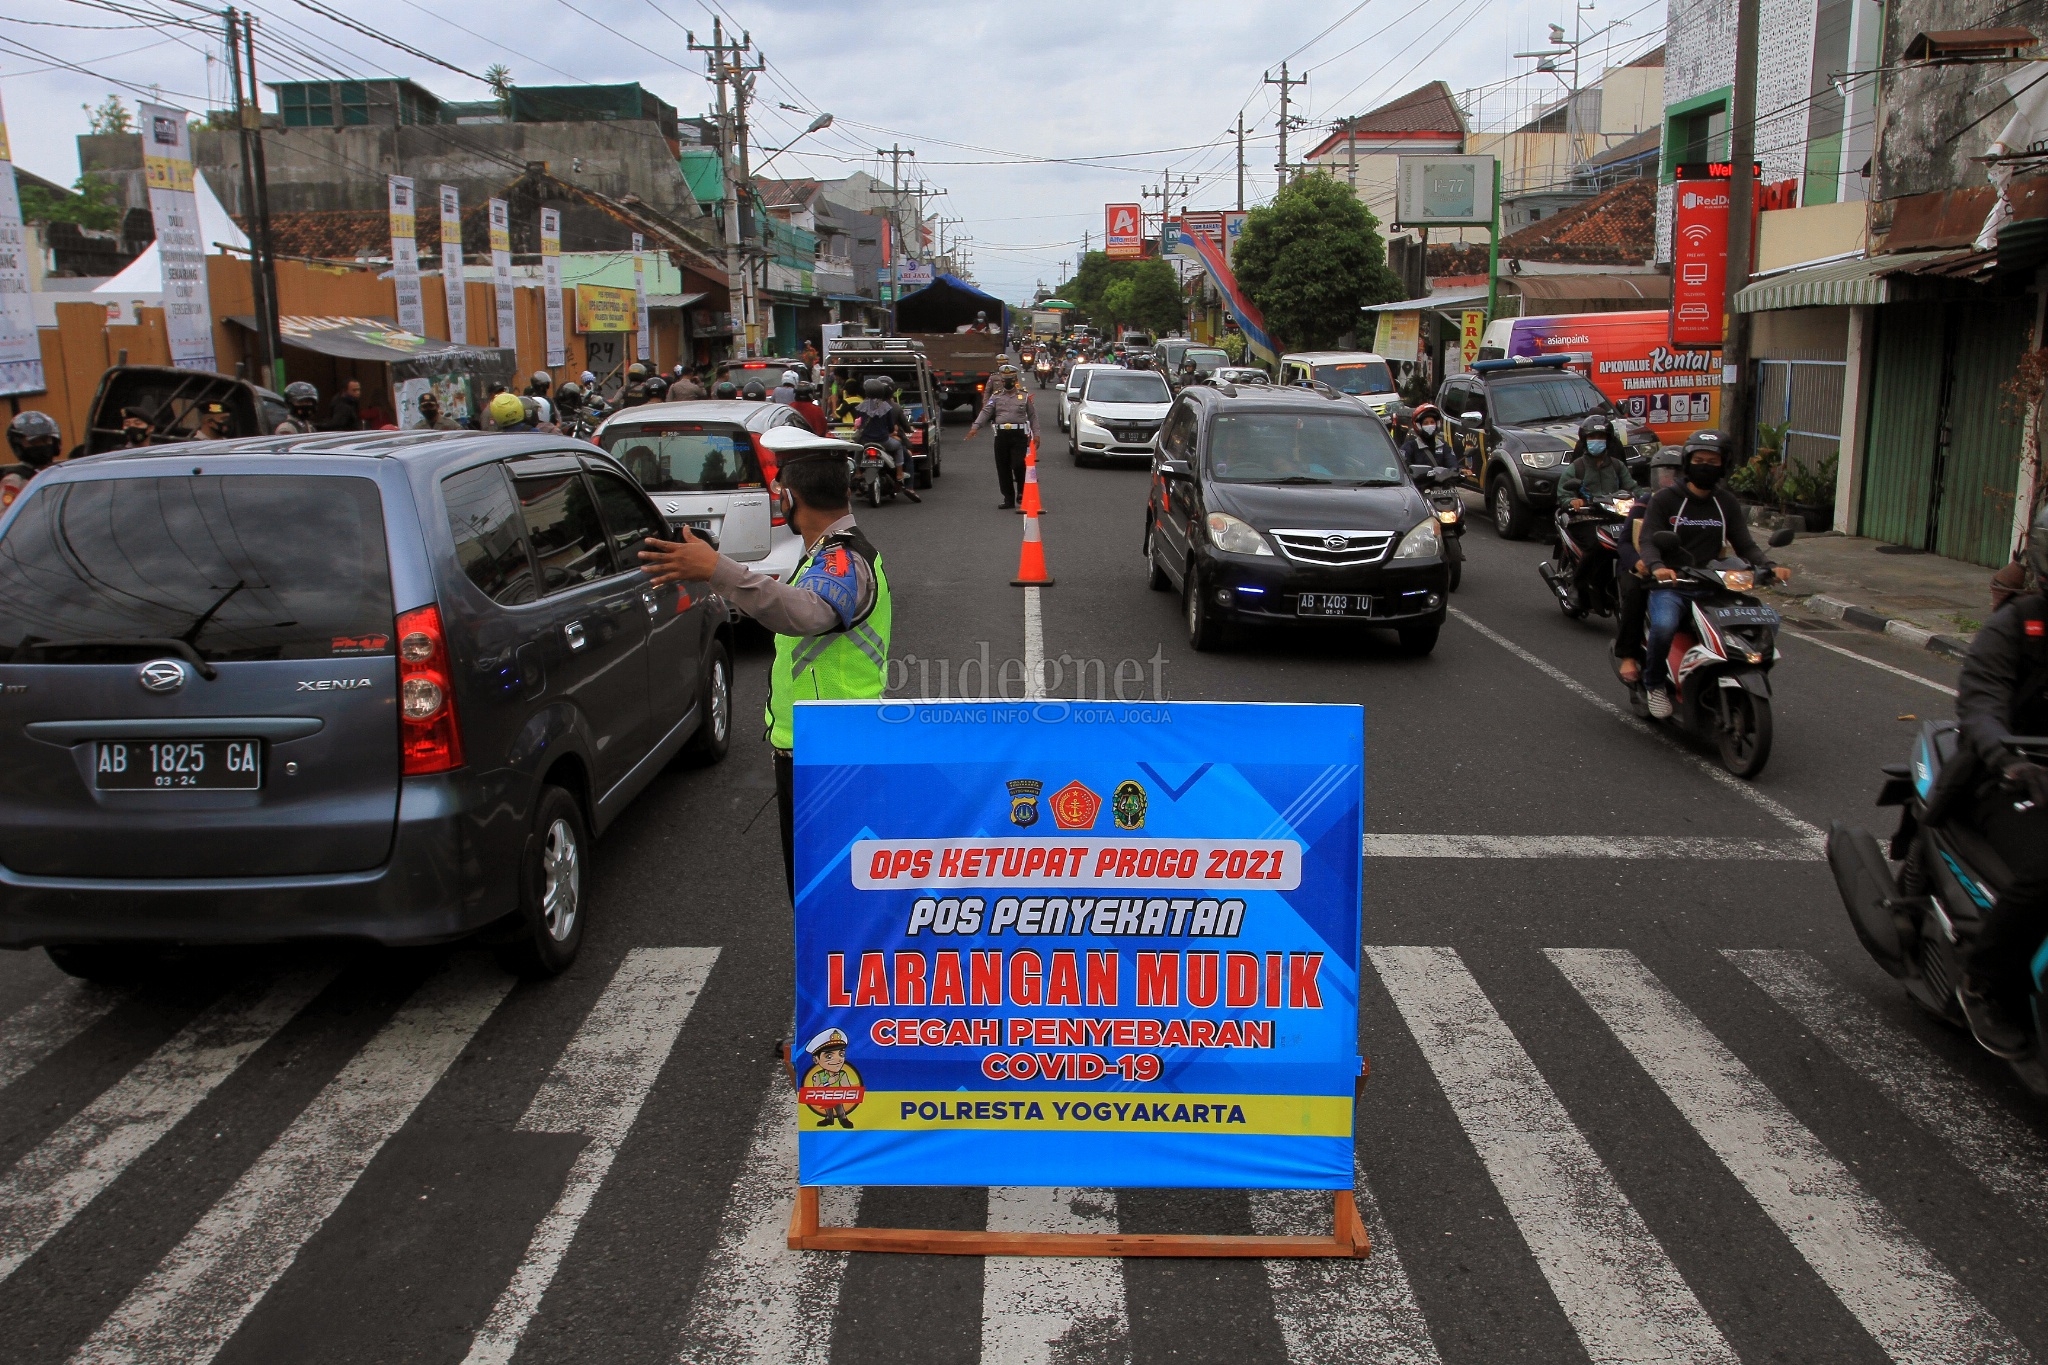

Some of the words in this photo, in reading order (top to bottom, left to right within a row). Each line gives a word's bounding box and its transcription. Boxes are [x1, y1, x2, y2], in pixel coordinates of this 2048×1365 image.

[1547, 333, 1590, 349] asianpaints
[1599, 359, 1650, 374] APKOVALUE
[1621, 376, 1669, 390] TAHANNYA
[1669, 374, 1695, 388] LAMA
[1301, 594, 1315, 608] AB
[1322, 595, 1348, 609] 1403
[1356, 596, 1369, 610] IU
[296, 677, 373, 692] XENIA
[98, 744, 128, 773] AB
[150, 743, 205, 773] 1825
[226, 743, 255, 772] GA
[869, 849, 933, 880] OPS
[938, 847, 1089, 879] KETUPAT
[1094, 848, 1199, 879] PROGO
[1204, 849, 1285, 880] 2021
[907, 897, 986, 937] POS
[990, 896, 1248, 938] PENYEKATAN
[826, 948, 1119, 1008] LARANGAN
[1136, 949, 1326, 1011] MUDIK
[870, 1017, 1003, 1048] CEGAH
[1008, 1018, 1276, 1049] PENYEBARAN
[980, 1052, 1165, 1082] COVID-19
[805, 1089, 860, 1100] PRESISI
[900, 1100, 1041, 1121] POLRESTA
[1056, 1101, 1247, 1124] YOGYAKARTA
